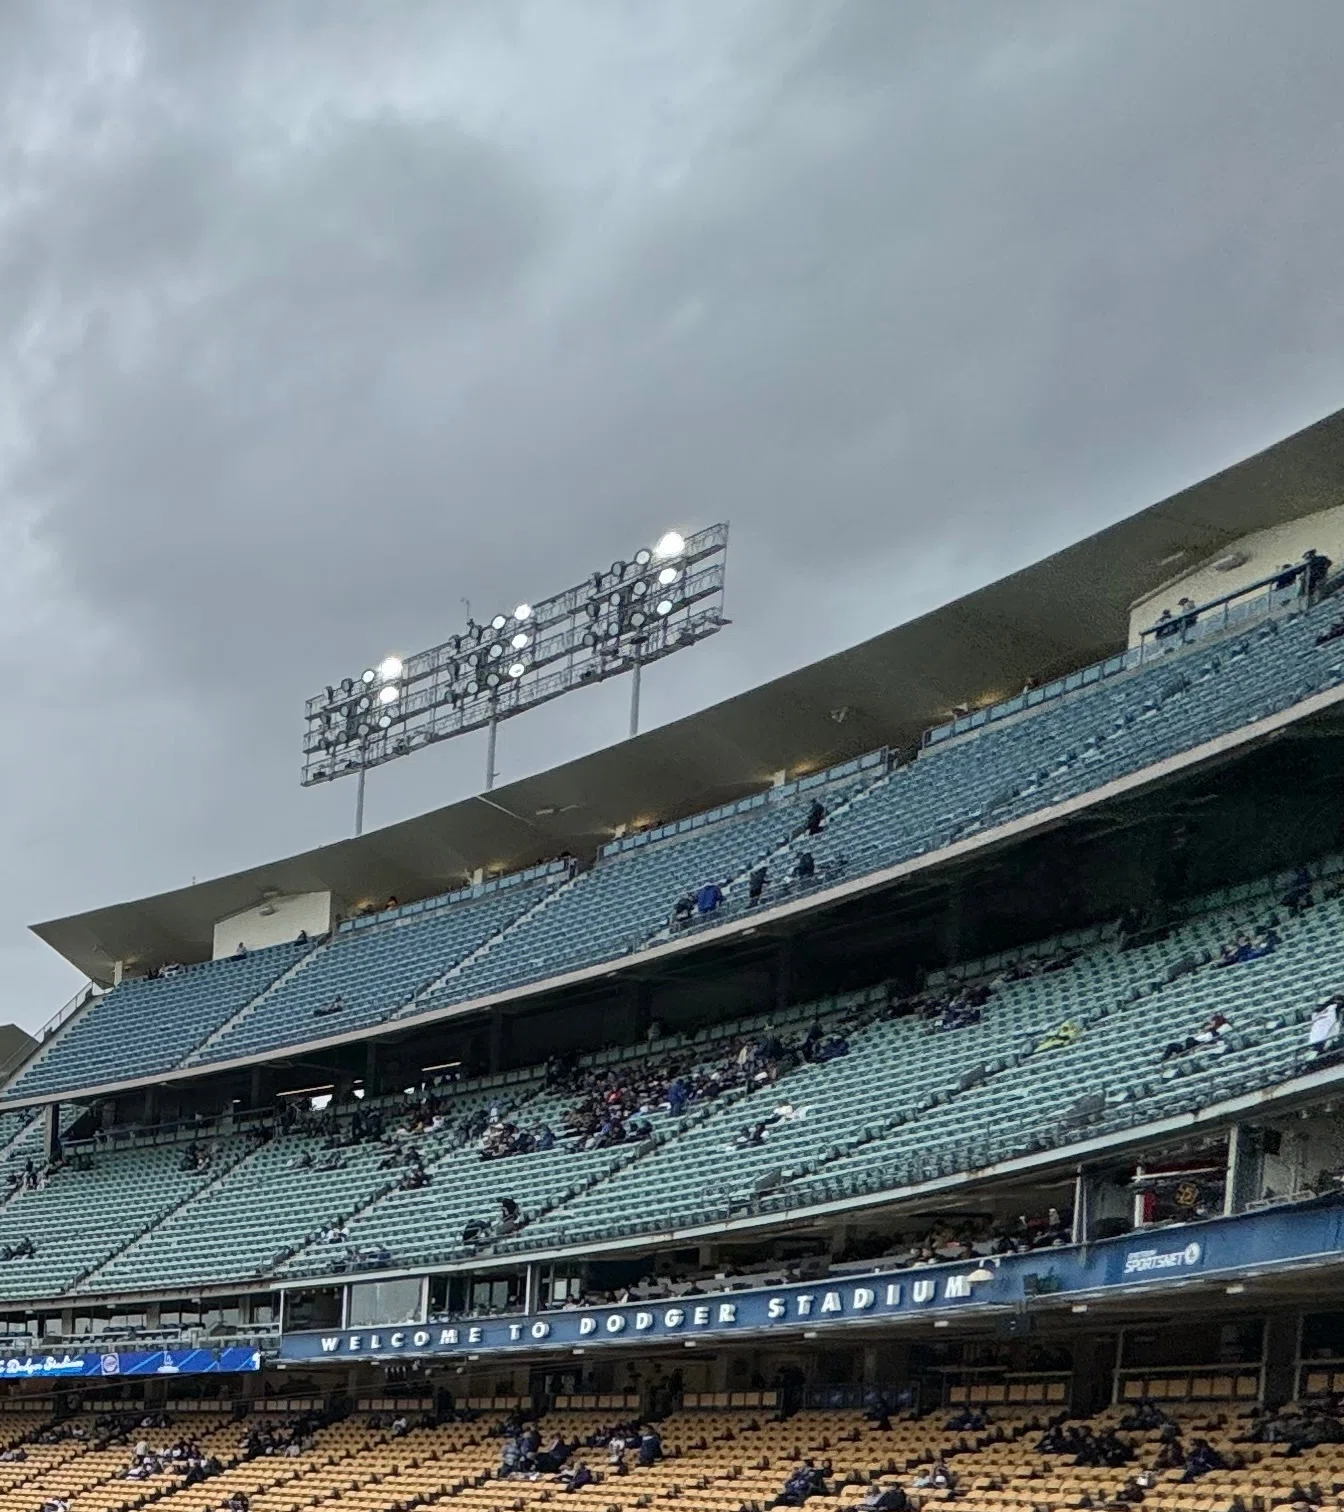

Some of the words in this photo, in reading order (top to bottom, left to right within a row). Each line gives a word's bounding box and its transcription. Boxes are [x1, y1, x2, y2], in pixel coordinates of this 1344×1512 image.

[321, 1325, 483, 1353] WELCOME
[508, 1320, 549, 1340] TO
[580, 1302, 735, 1336] DODGER
[767, 1274, 973, 1319] STADIUM
